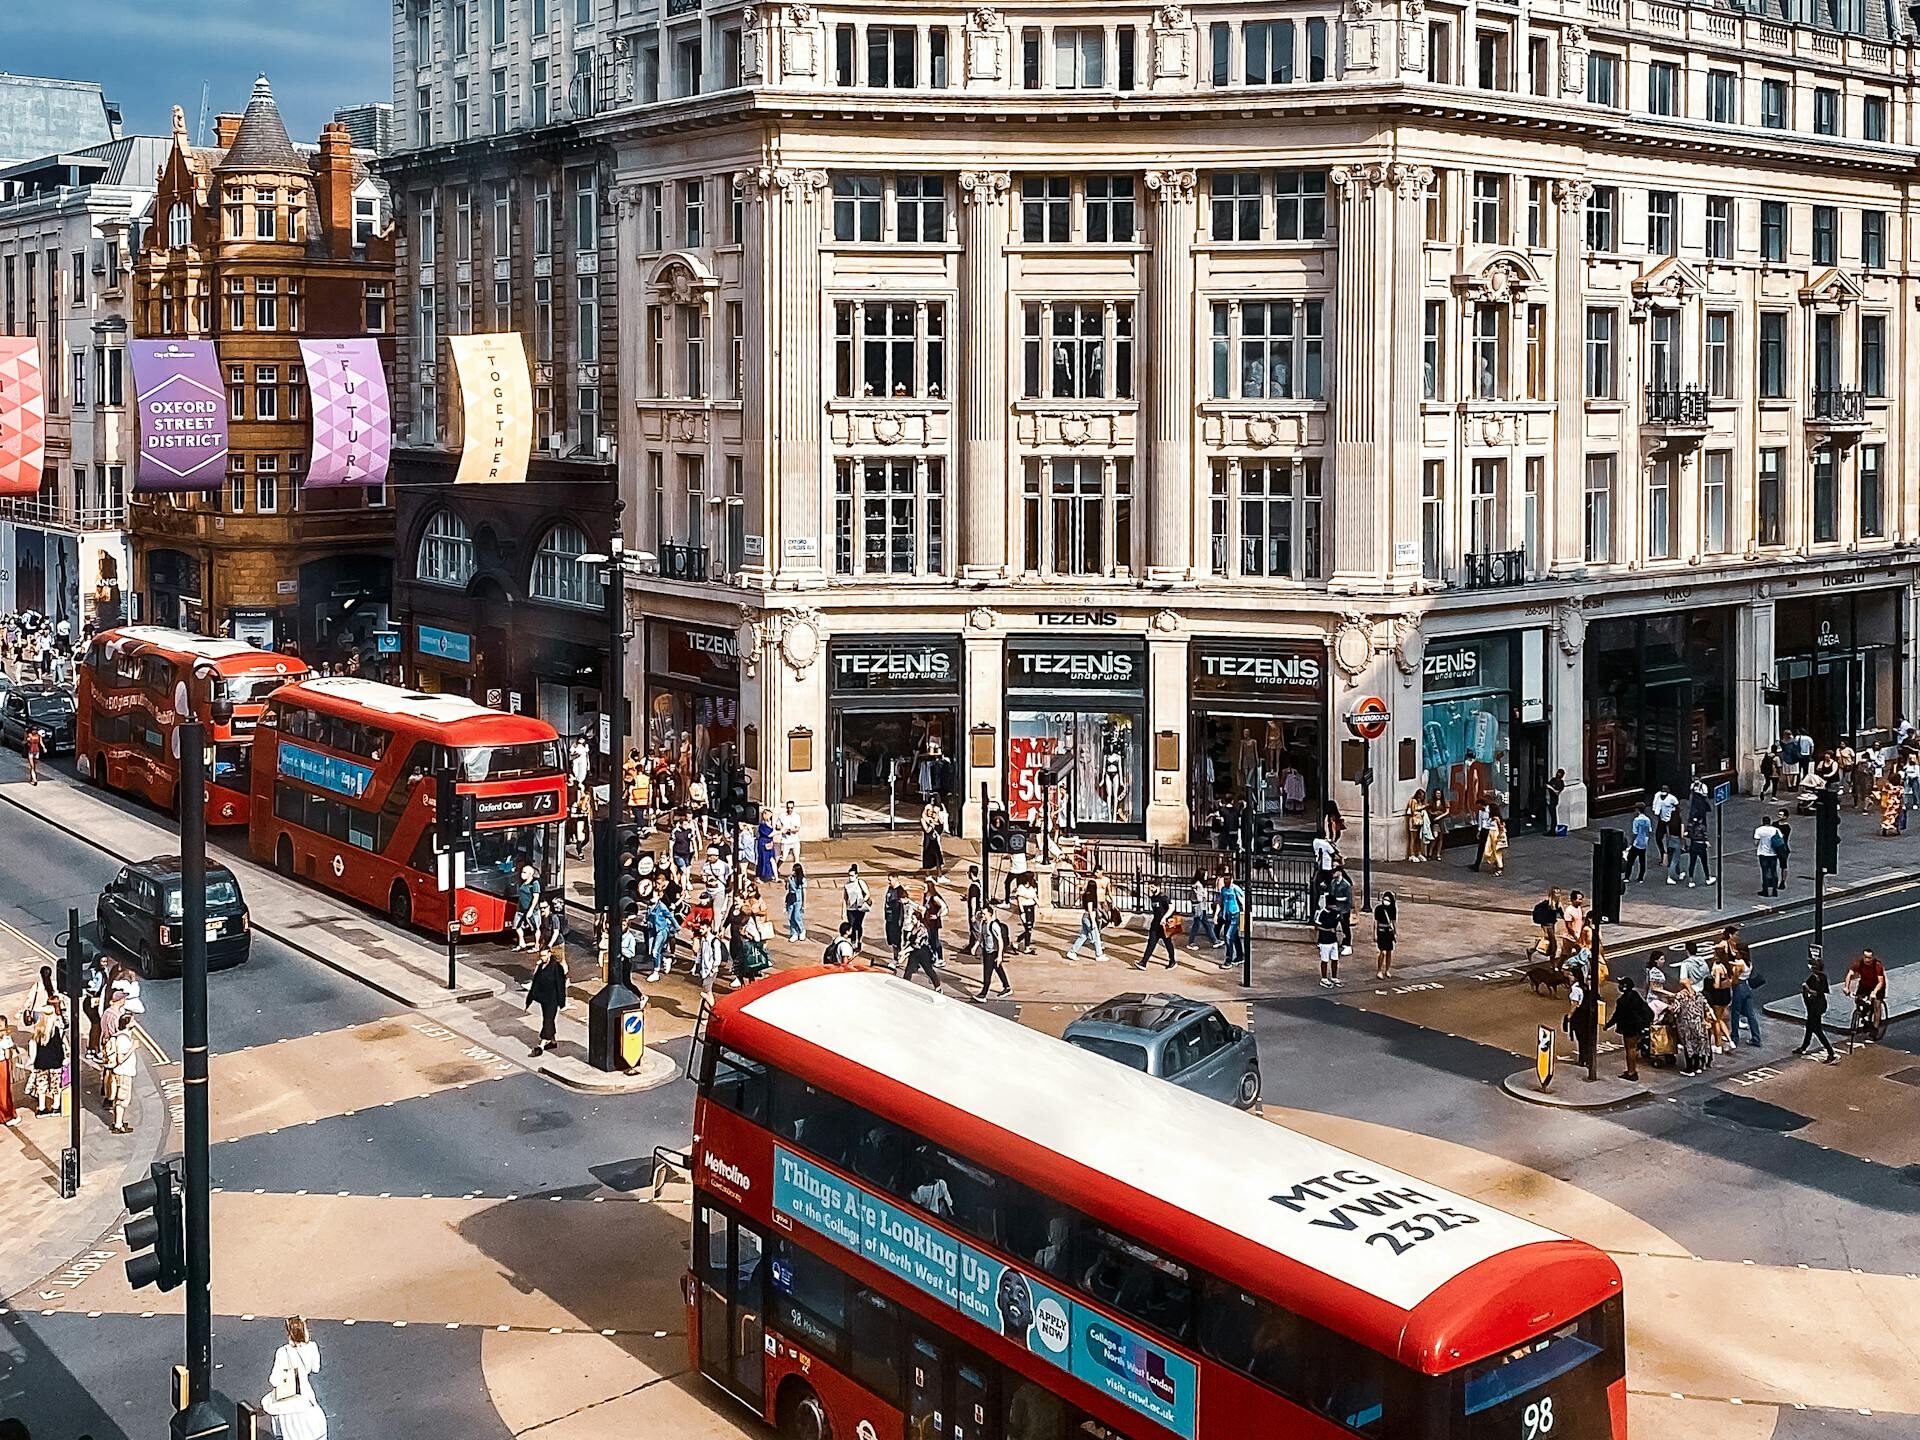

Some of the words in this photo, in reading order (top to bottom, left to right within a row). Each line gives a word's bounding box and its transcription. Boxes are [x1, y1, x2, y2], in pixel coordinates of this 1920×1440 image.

[149, 401, 217, 414] OXFORD
[488, 356, 504, 478] TOGETHER
[154, 417, 215, 431] STREET
[148, 433, 222, 448] DISTRICT
[1663, 588, 1691, 600] KIKO
[888, 671, 949, 680] underwear
[1070, 672, 1132, 680] underwear
[1255, 677, 1319, 686] underwear
[1434, 669, 1475, 680] underwear
[479, 802, 502, 812] Oxford
[502, 802, 523, 810] Circus
[533, 794, 552, 810] 73
[1728, 1067, 1784, 1087] LEFT
[704, 1150, 751, 1190] Metroline
[1268, 1170, 1380, 1213] MTG
[1308, 1187, 1439, 1231] VWH
[781, 1157, 841, 1209] Things
[843, 1191, 876, 1229] Are
[880, 1209, 958, 1278] Looking
[961, 1253, 991, 1294] Up
[1364, 1207, 1480, 1256] 2325
[792, 1199, 803, 1212] at
[805, 1202, 821, 1223] the
[865, 1237, 877, 1253] of
[880, 1242, 912, 1273] North
[914, 1261, 943, 1290] West
[946, 1279, 990, 1317] London
[51, 1250, 118, 1289] RIGHT
[1038, 1309, 1067, 1331] APPLY
[1041, 1321, 1064, 1342] NOW
[1089, 1329, 1117, 1351] College
[1118, 1345, 1127, 1355] of
[1103, 1348, 1126, 1368] North
[1126, 1359, 1145, 1378] West
[1146, 1371, 1174, 1395] London
[1524, 1396, 1554, 1440] 98
